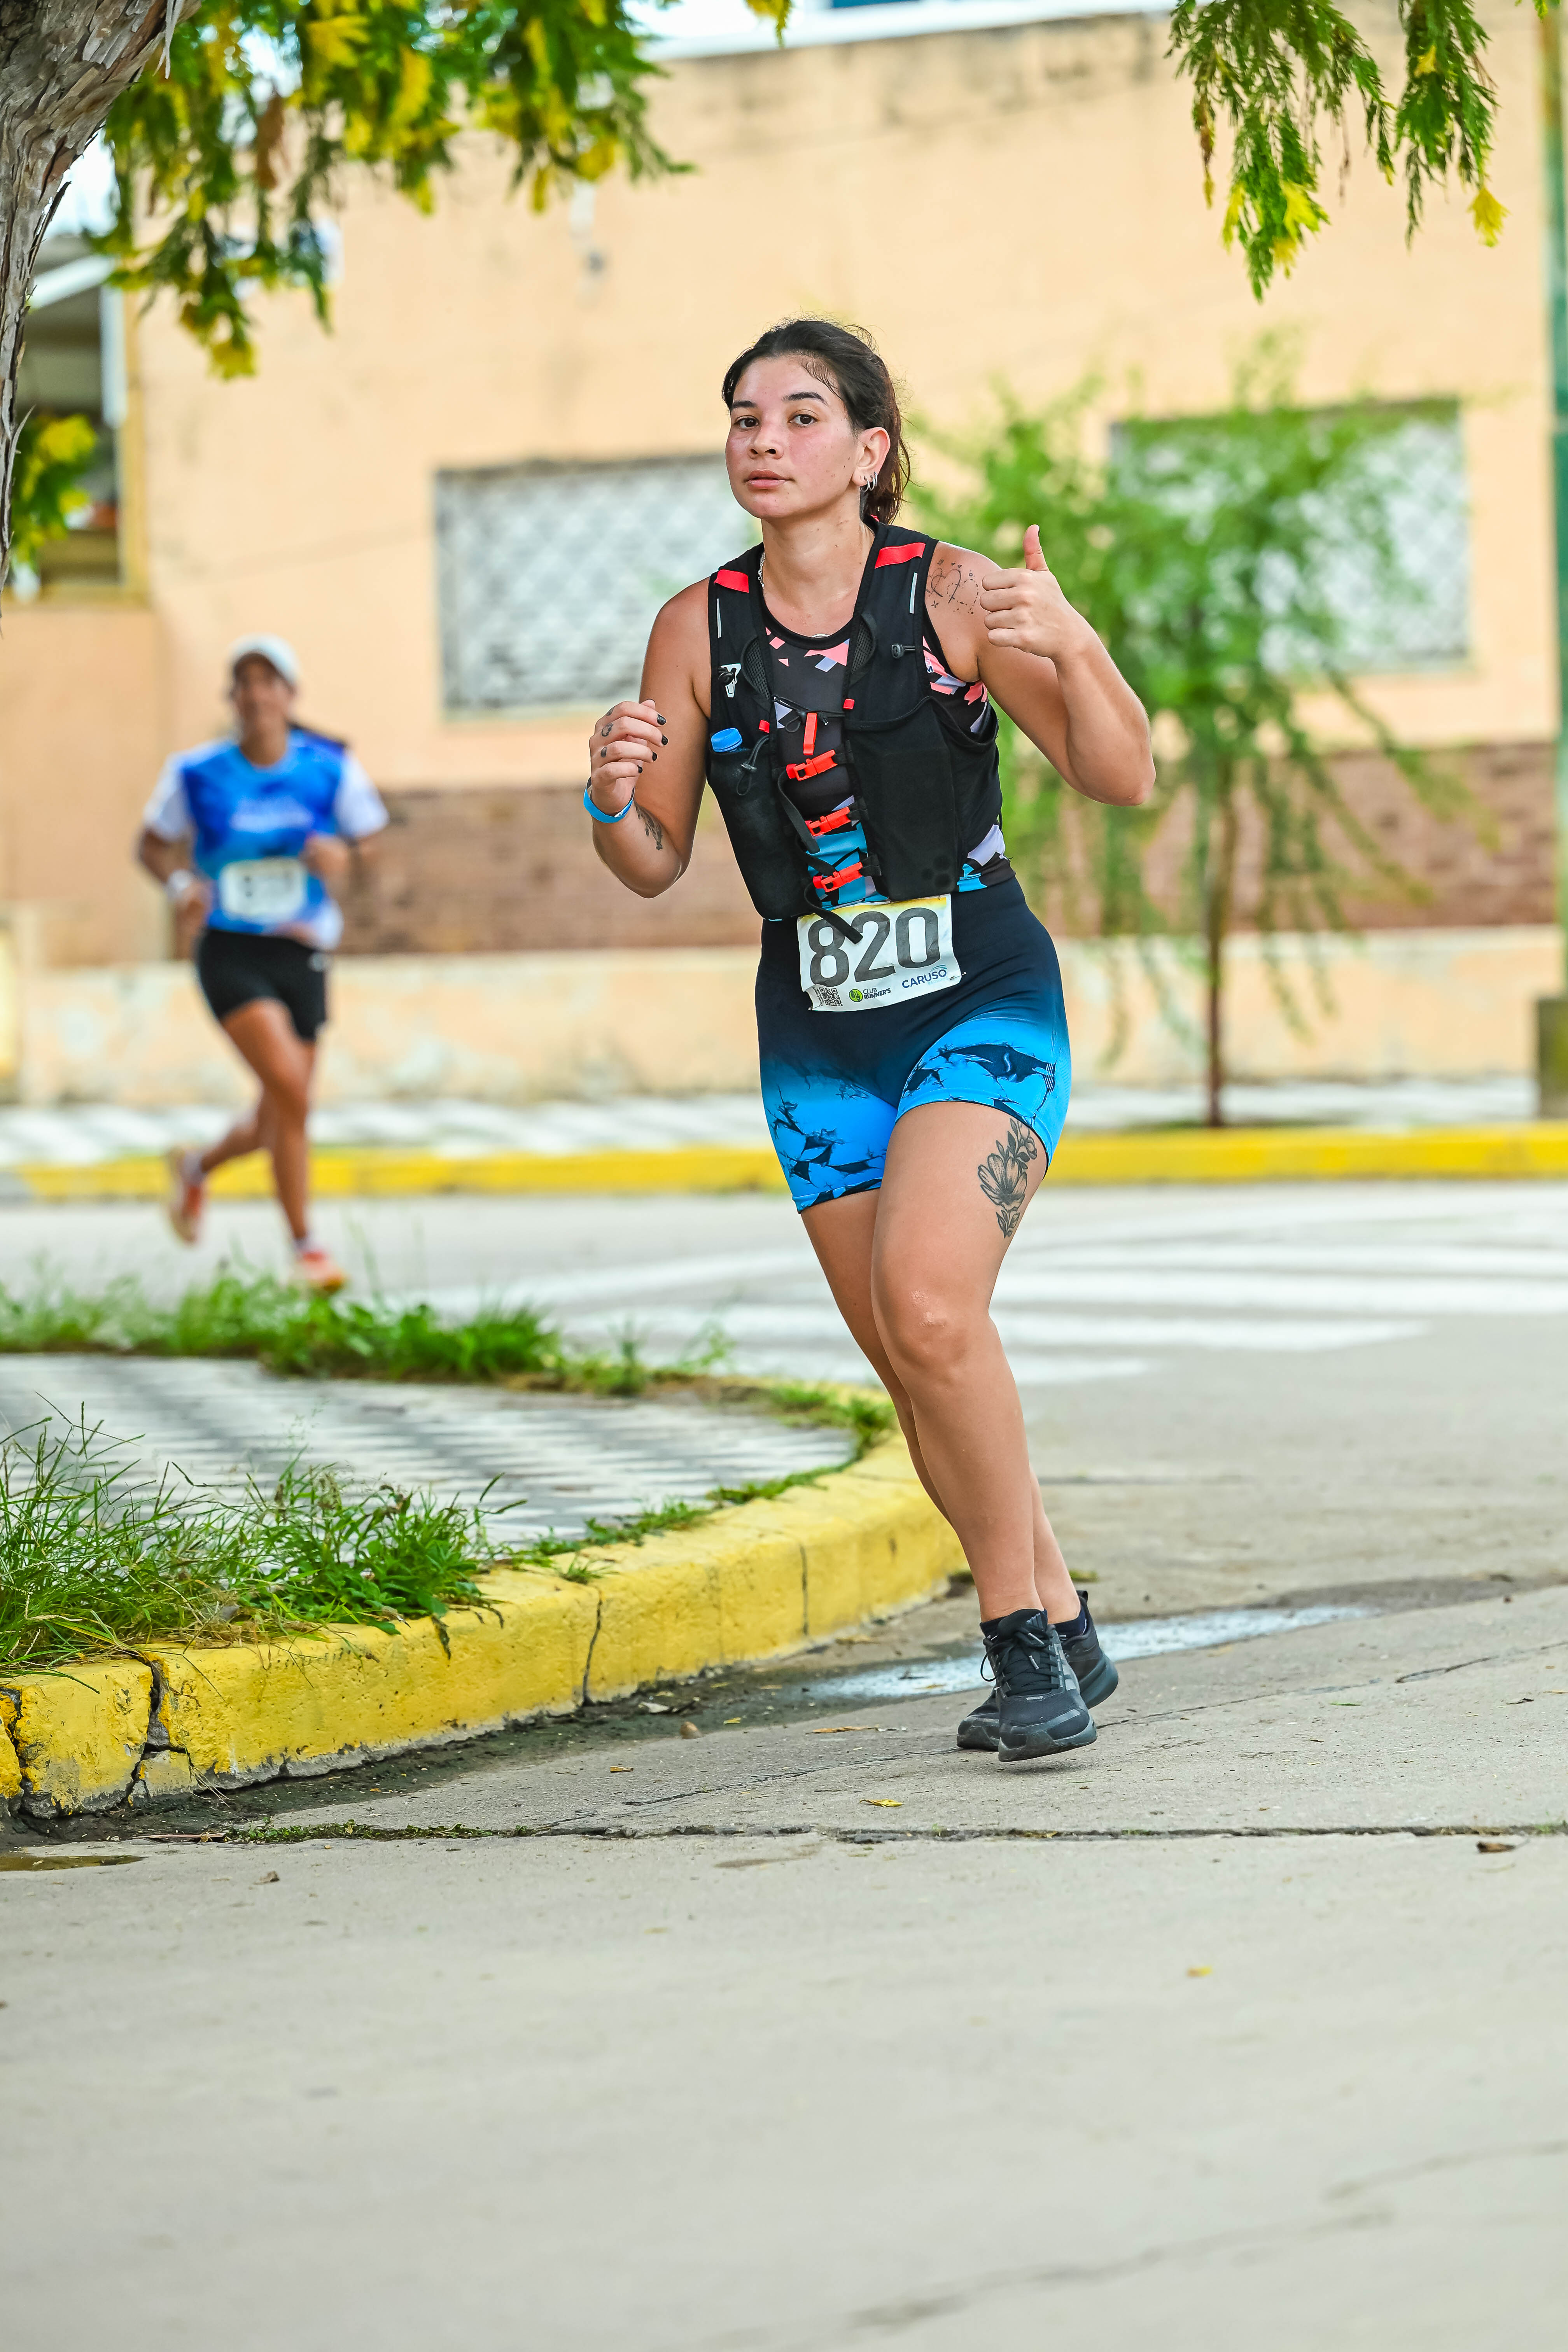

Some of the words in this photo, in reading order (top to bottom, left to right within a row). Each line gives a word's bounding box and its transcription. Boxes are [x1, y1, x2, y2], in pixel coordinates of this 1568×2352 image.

[808, 908, 940, 987] 820
[902, 969, 947, 988] CARUSO
[864, 988, 891, 999] RUNNER'S
